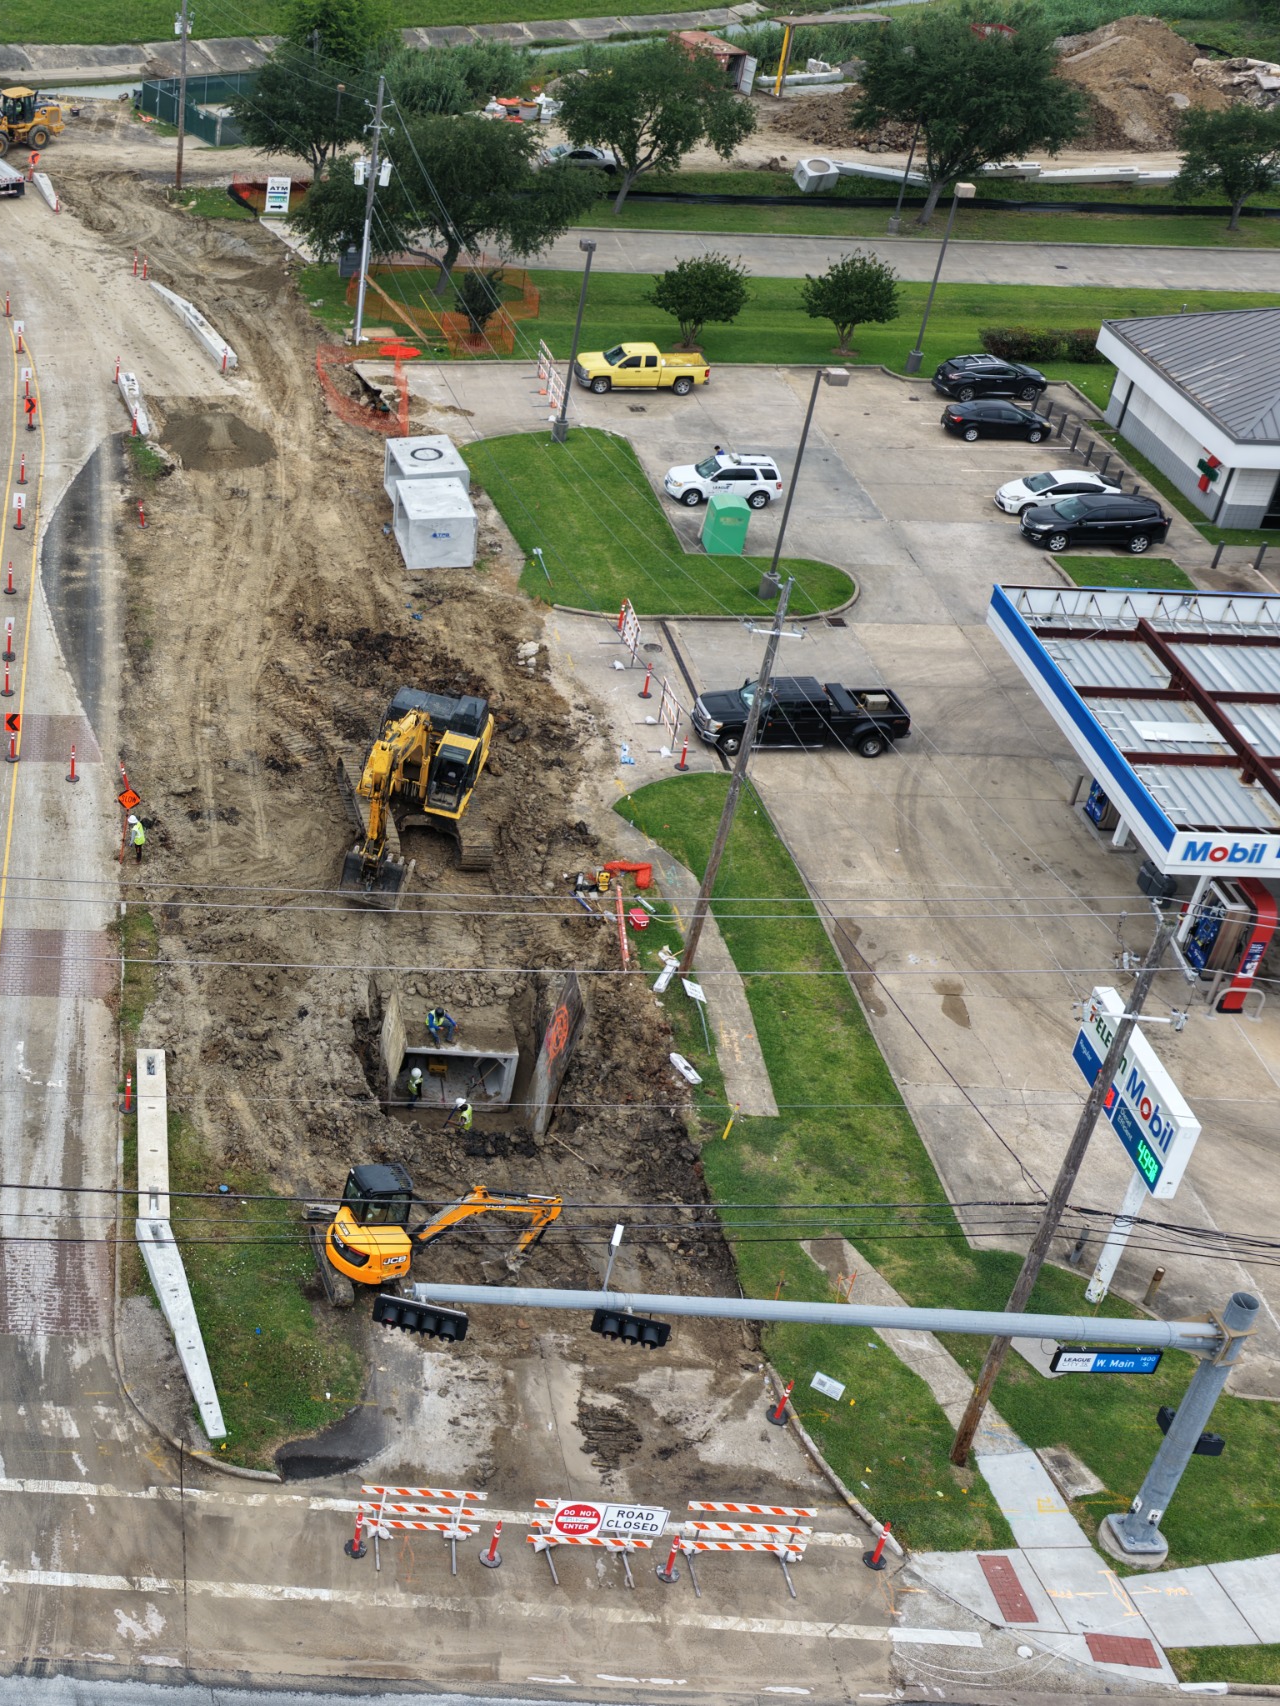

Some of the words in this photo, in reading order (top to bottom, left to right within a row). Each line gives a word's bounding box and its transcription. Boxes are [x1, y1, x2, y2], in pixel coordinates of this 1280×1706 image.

[121, 795, 136, 803] SLOW
[1181, 840, 1268, 864] Mobil
[1126, 1065, 1174, 1154] Mobil
[383, 1255, 407, 1266] JCB
[1096, 1359, 1106, 1367] W.
[1109, 1359, 1135, 1368] Main
[616, 1510, 655, 1521] ROAD
[606, 1519, 659, 1532] CLOSED
